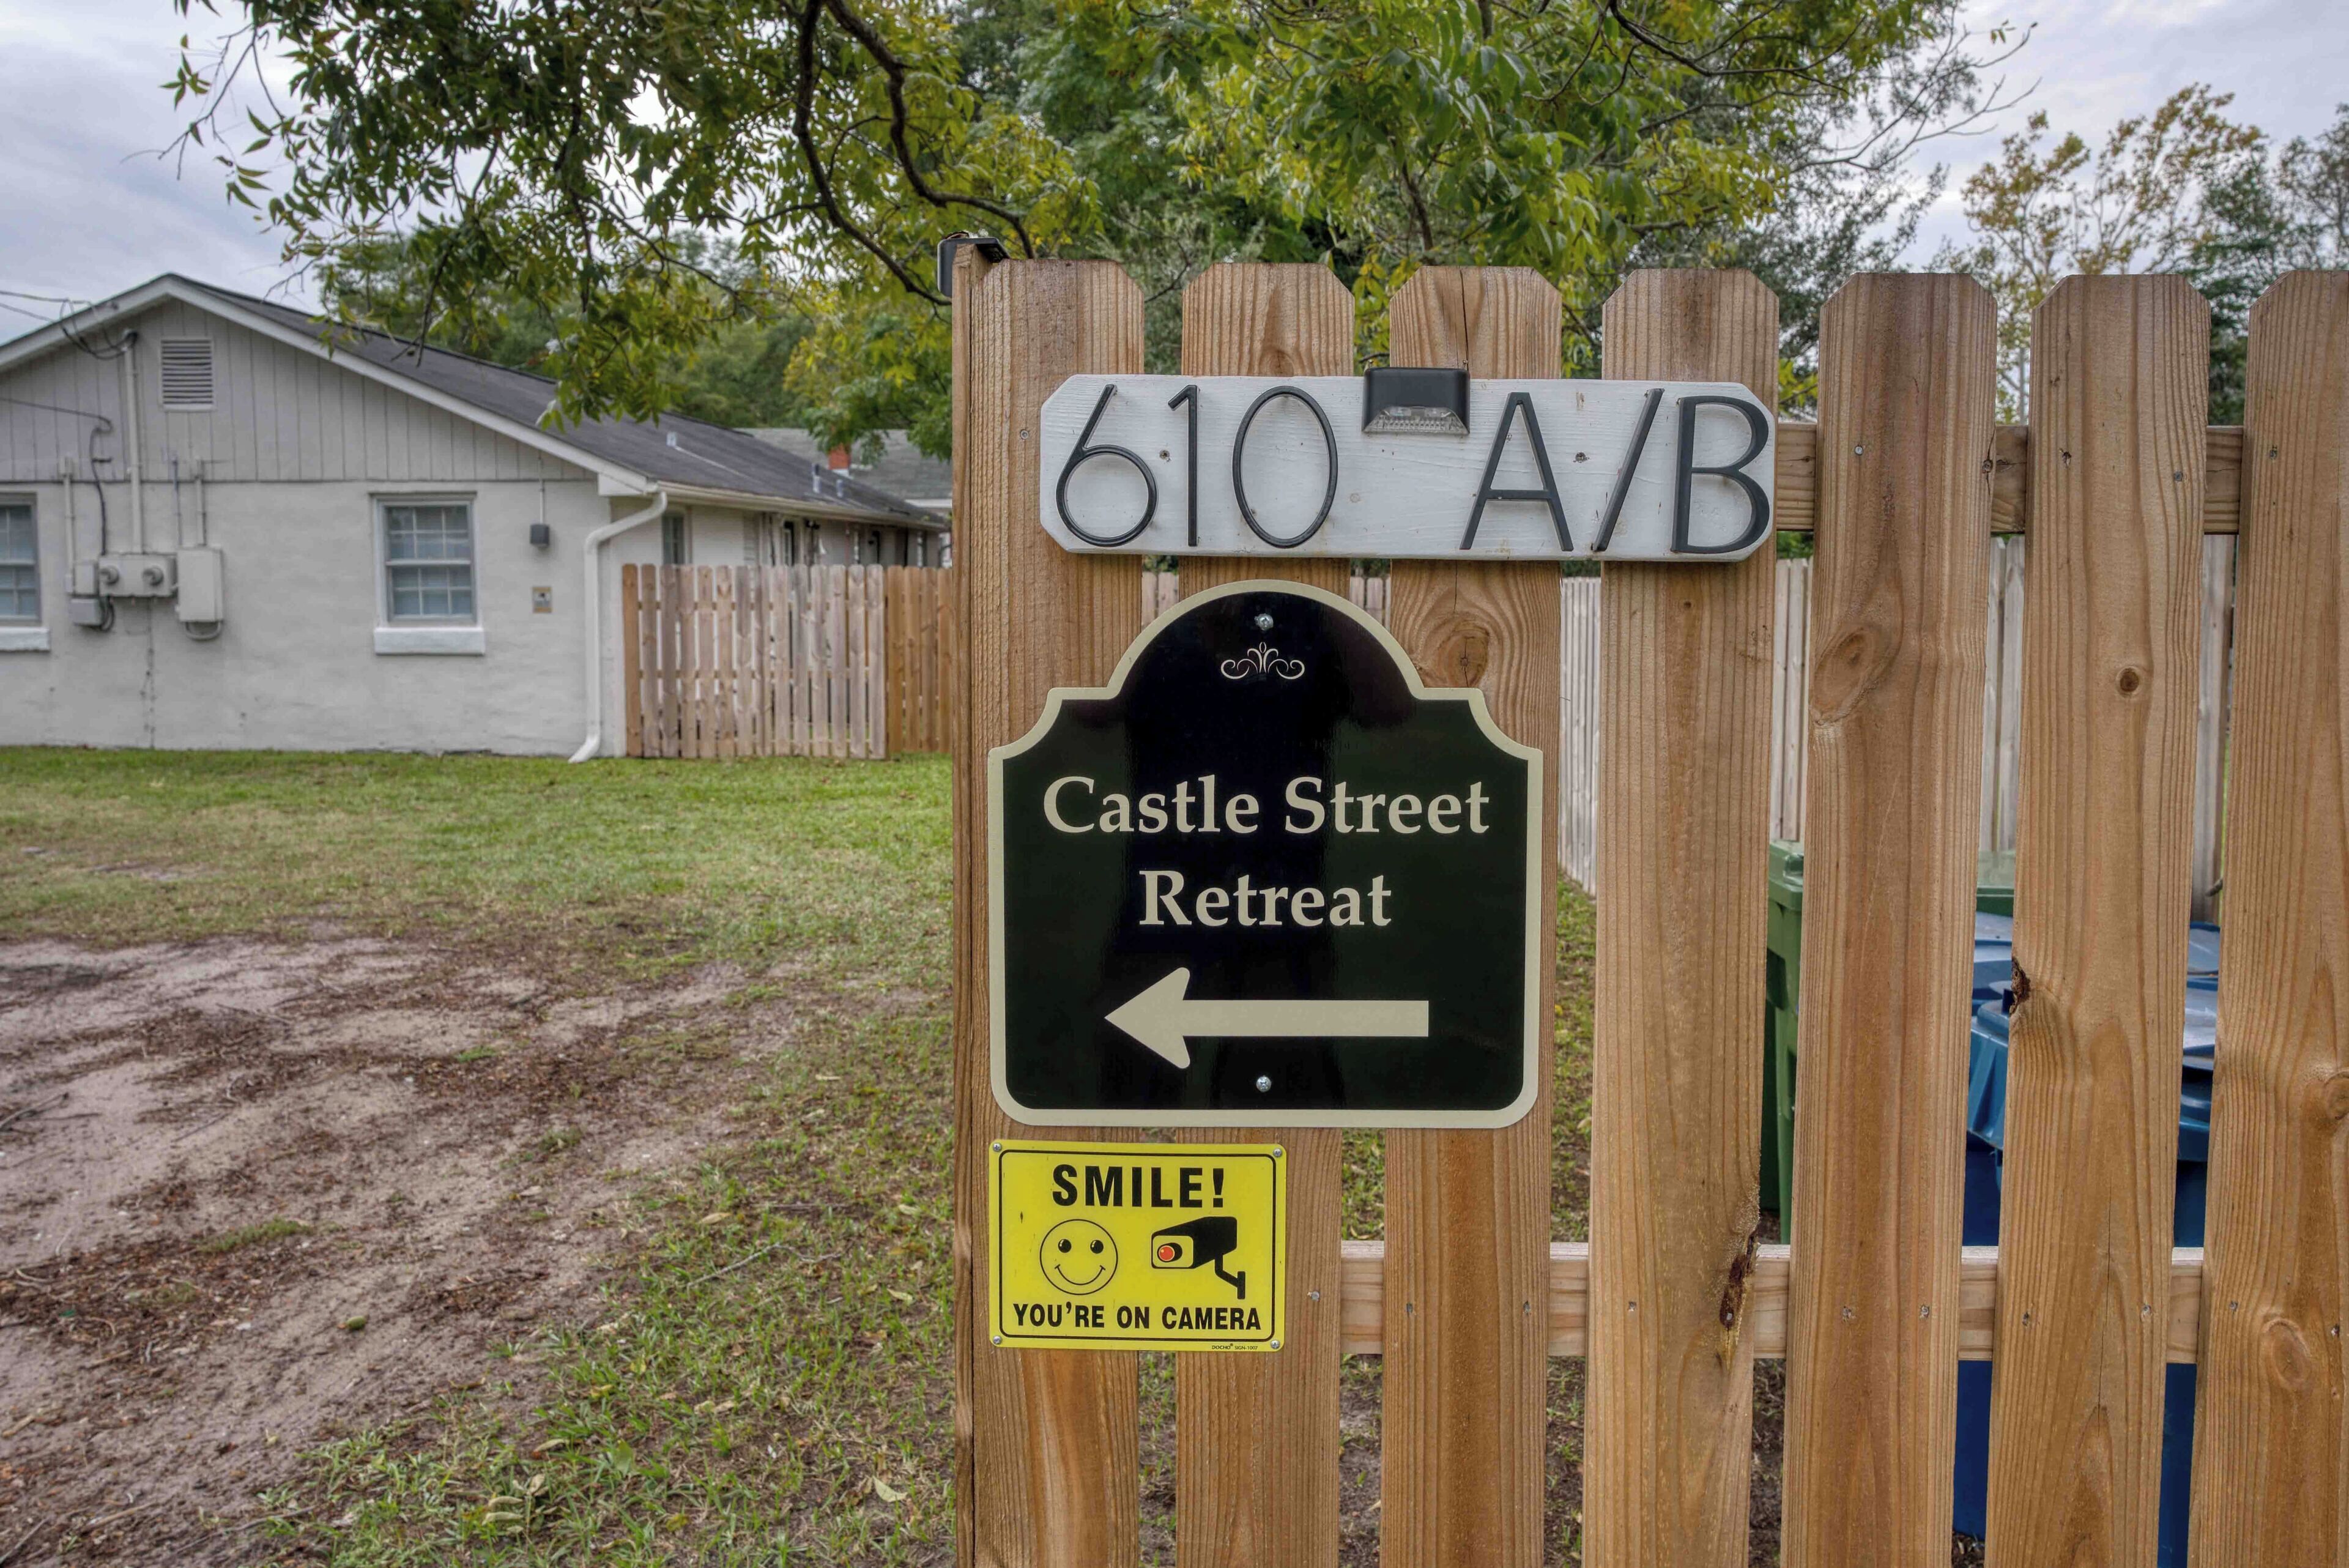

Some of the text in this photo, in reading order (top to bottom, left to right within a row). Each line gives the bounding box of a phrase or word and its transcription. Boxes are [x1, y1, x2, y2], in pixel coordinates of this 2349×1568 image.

[1056, 384, 1770, 554] 610 A/B
[1044, 774, 1489, 834] Castle Street
[1139, 870, 1392, 927] Retreat
[1052, 1164, 1224, 1208] SMILE!
[1013, 1301, 1261, 1330] YOU'RE ON CAMERA
